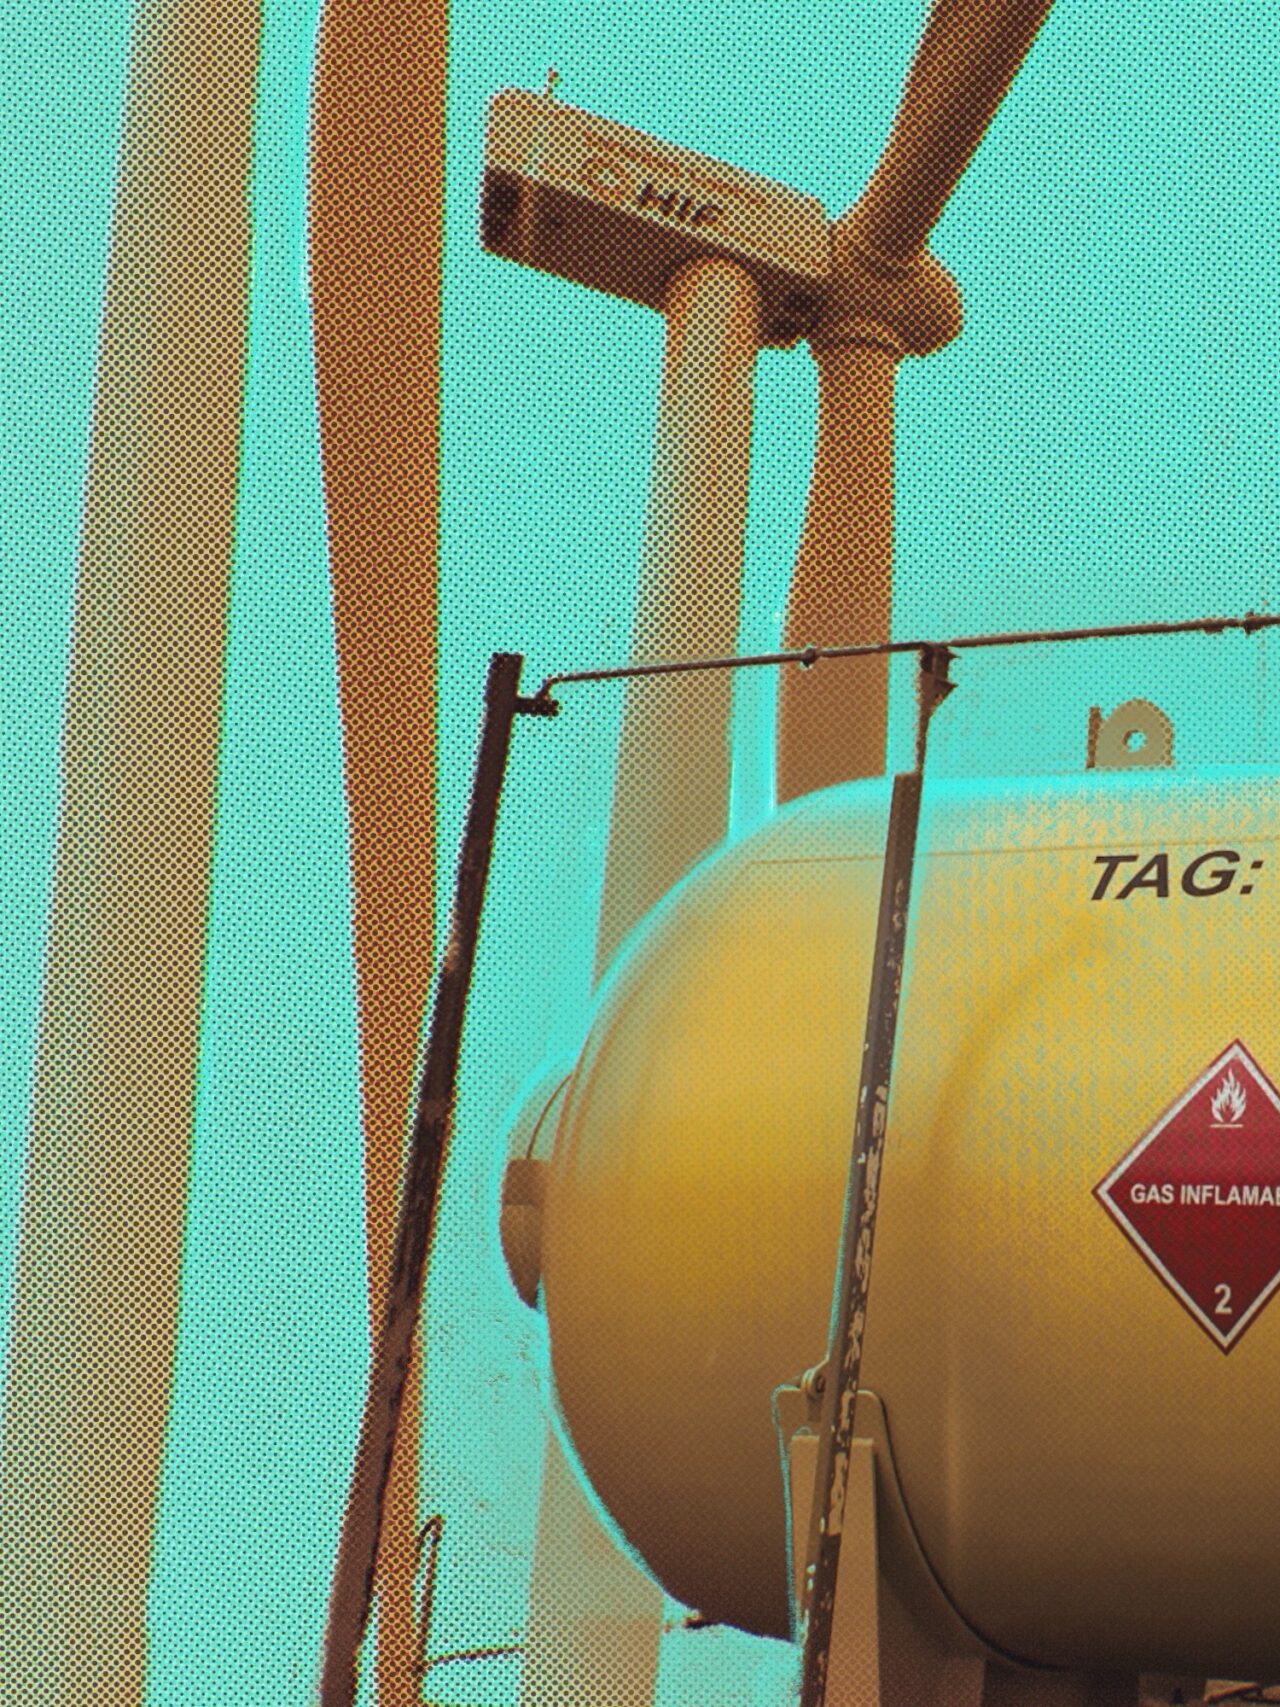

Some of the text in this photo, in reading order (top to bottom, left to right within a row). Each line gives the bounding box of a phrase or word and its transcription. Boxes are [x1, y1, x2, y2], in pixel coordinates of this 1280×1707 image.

[635, 182, 724, 227] HIF
[1091, 850, 1263, 900] TAG:
[1130, 1183, 1174, 1204] GAS
[1214, 1283, 1232, 1314] 2
